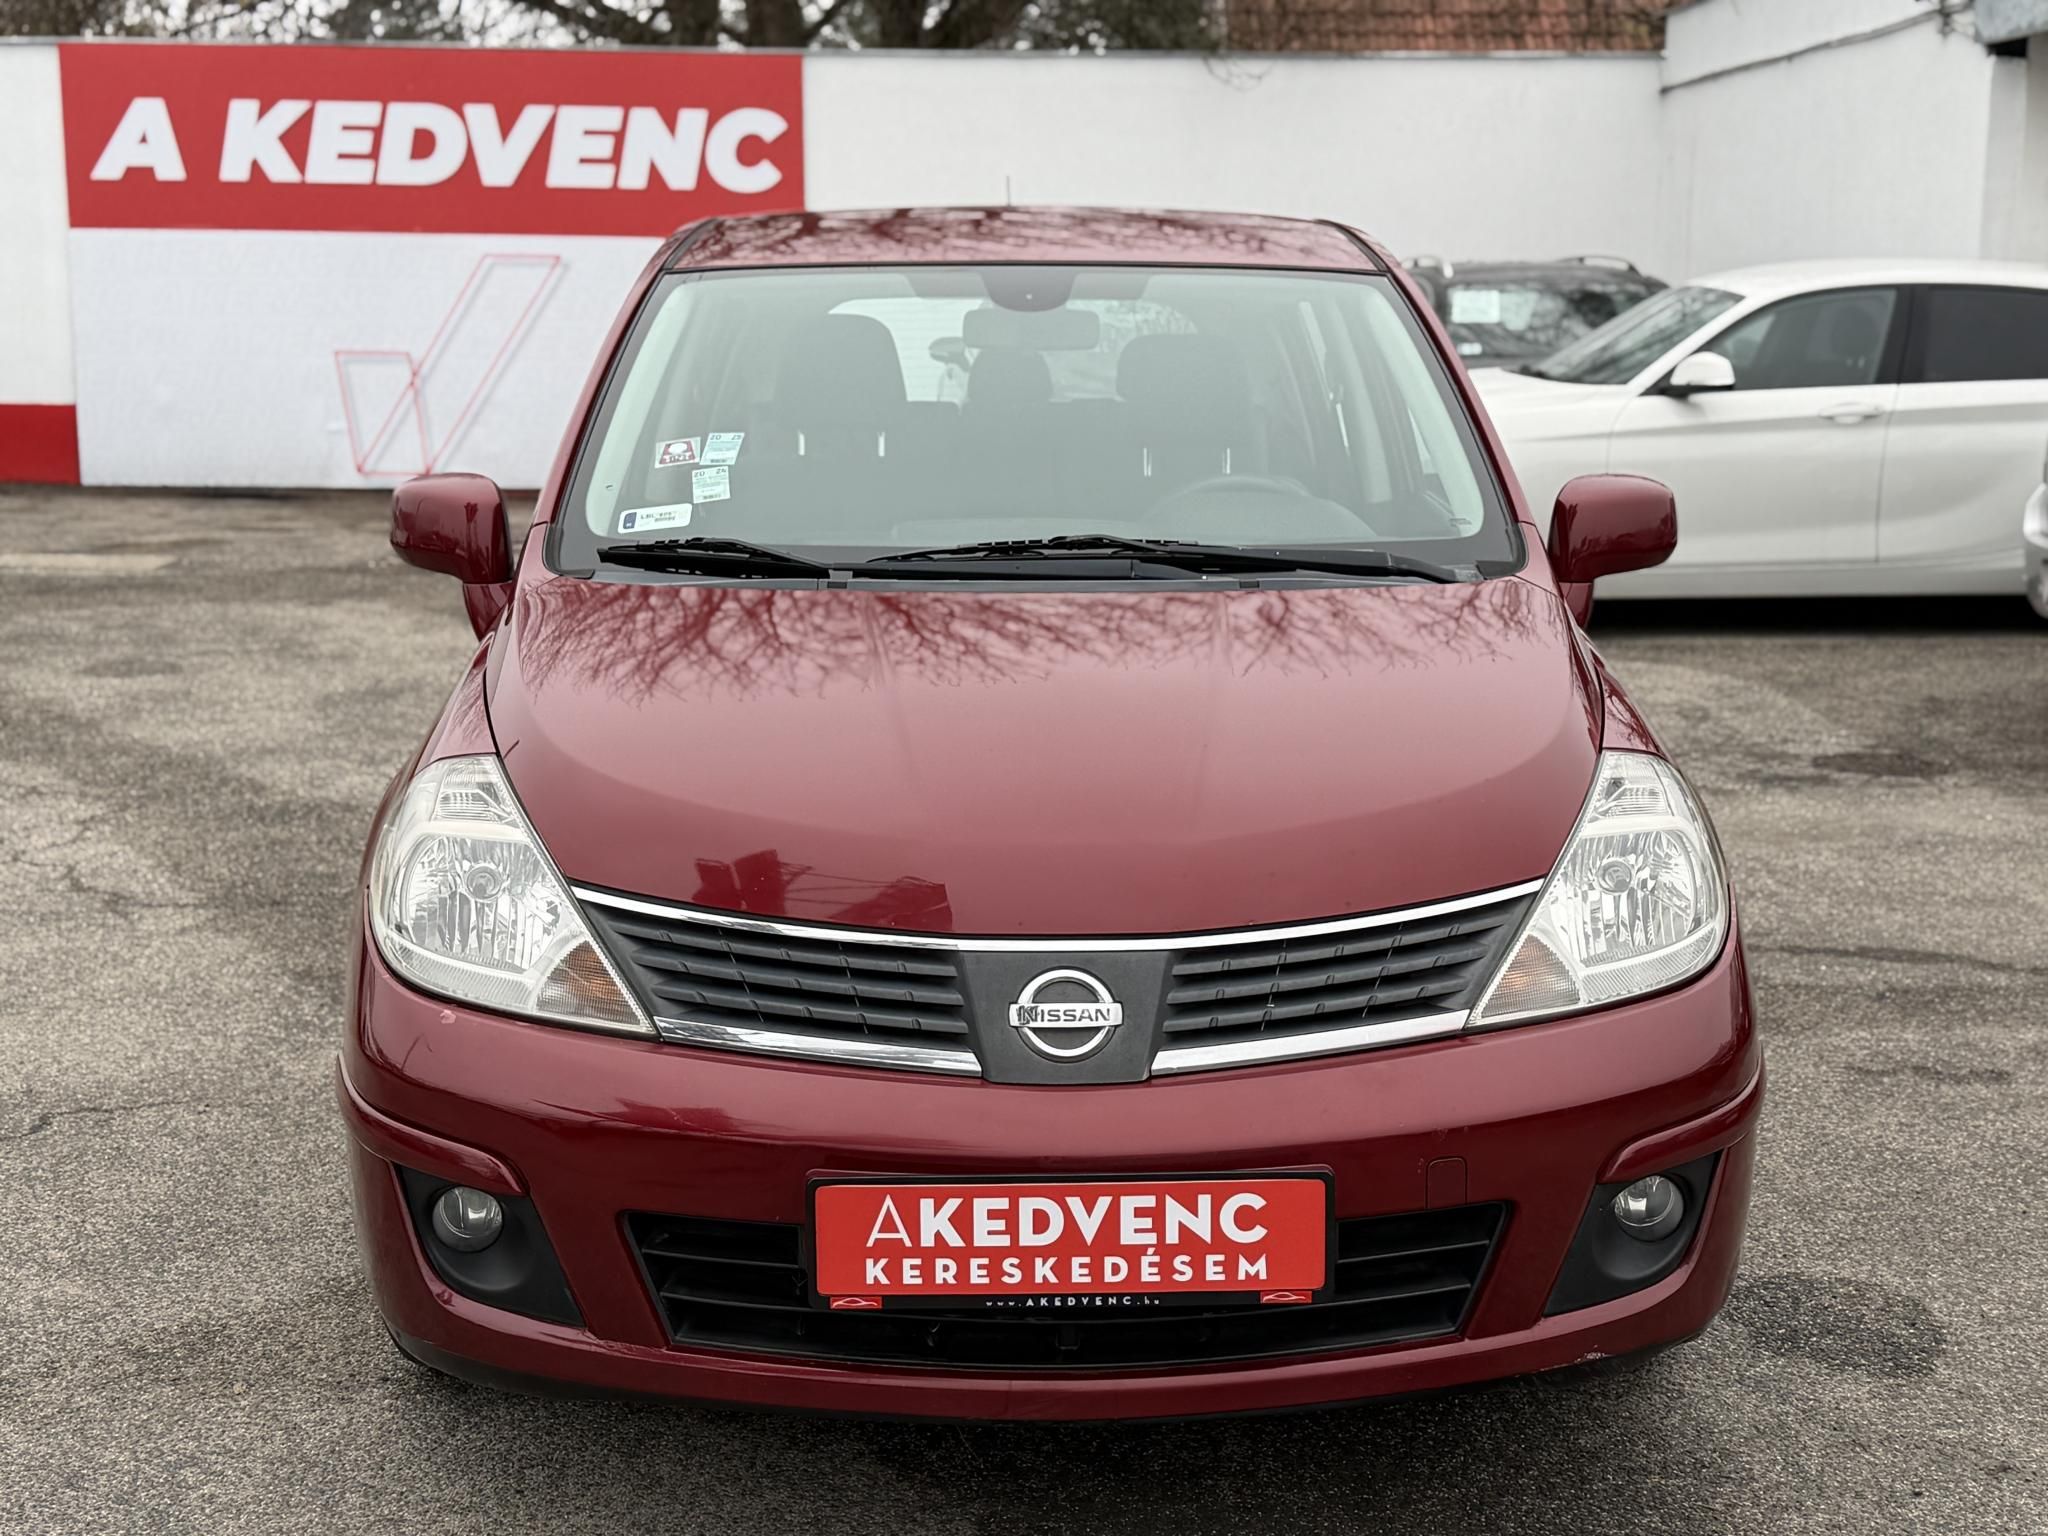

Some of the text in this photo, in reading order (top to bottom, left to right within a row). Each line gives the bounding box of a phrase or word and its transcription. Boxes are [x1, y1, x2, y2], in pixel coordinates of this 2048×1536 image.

[90, 97, 789, 194] A KEDVENC
[1017, 1006, 1110, 1023] NISSAN
[865, 1248, 1269, 1286] KERESKEDÉSEM
[985, 1296, 1160, 1307] www.AKEDVENC.hu
